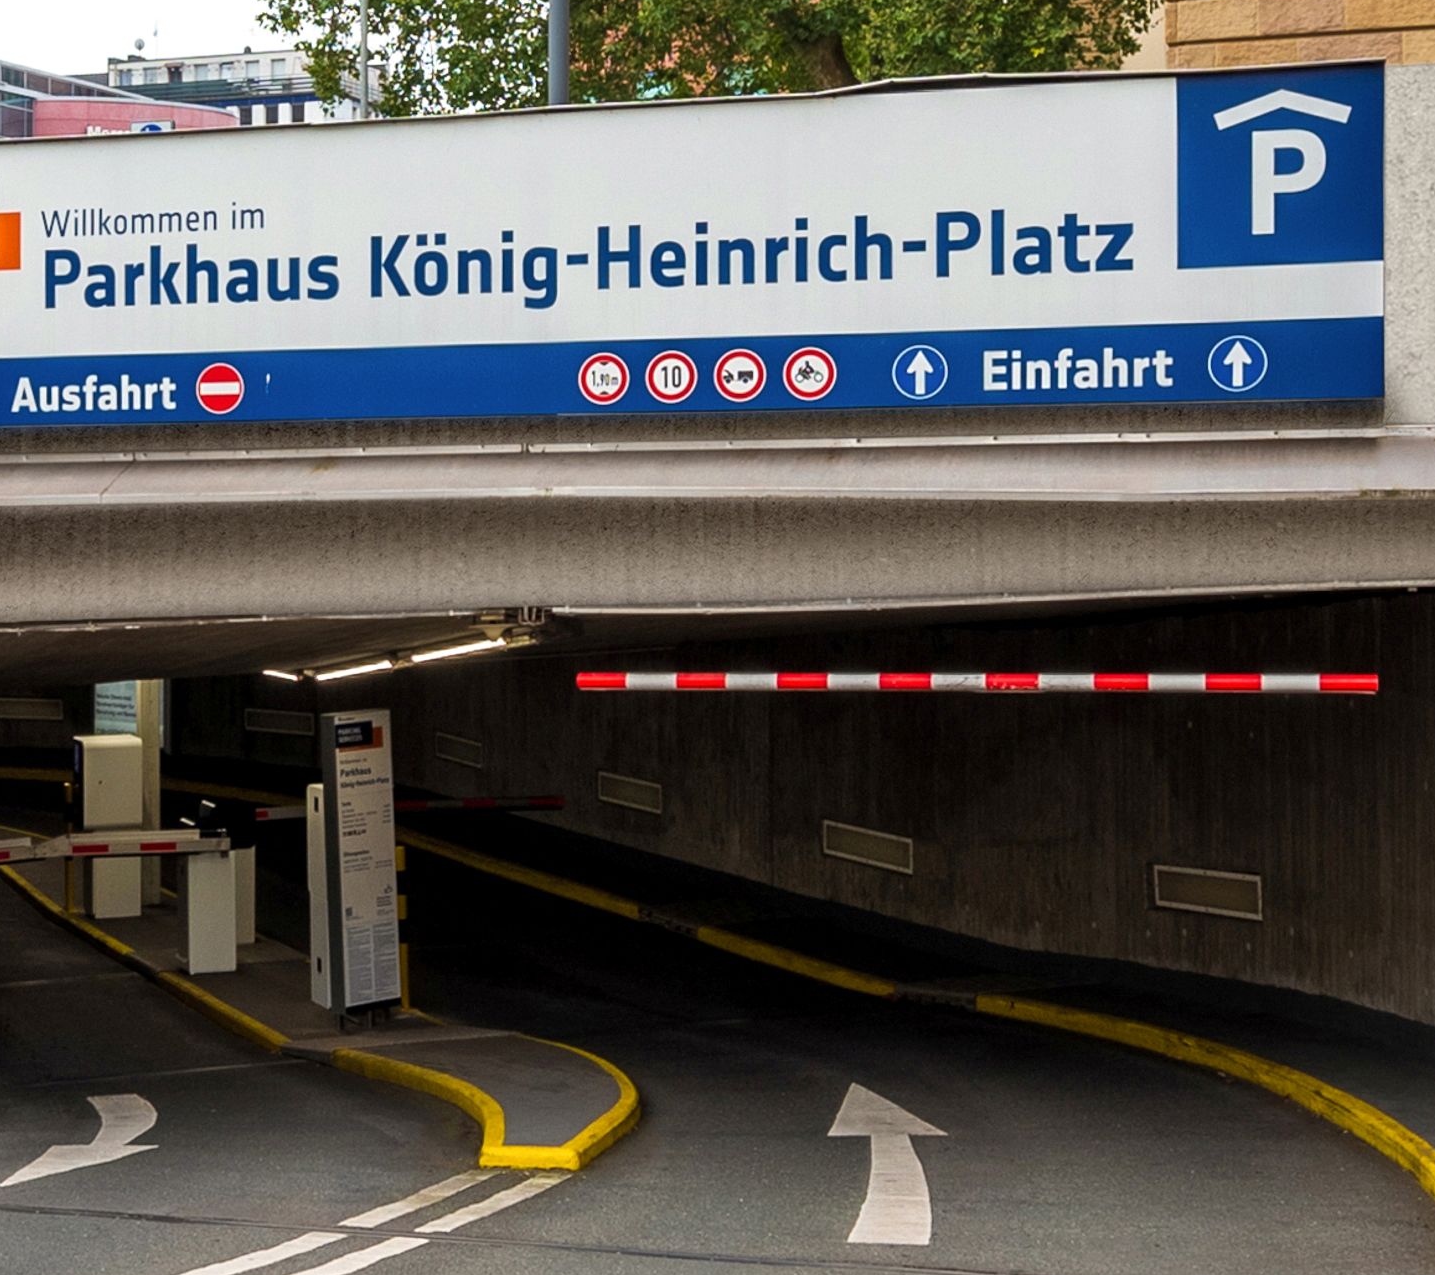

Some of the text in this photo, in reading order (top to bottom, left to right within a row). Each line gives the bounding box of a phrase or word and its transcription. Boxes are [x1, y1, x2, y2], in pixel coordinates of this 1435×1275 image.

[40, 201, 264, 238] Willkommen im
[1251, 129, 1327, 235] P
[44, 208, 1134, 310] Parkhaus König-Heinrich-Platz
[11, 374, 177, 413] Ausfahrt
[660, 364, 683, 389] 10
[983, 347, 1174, 391] Einfahrt
